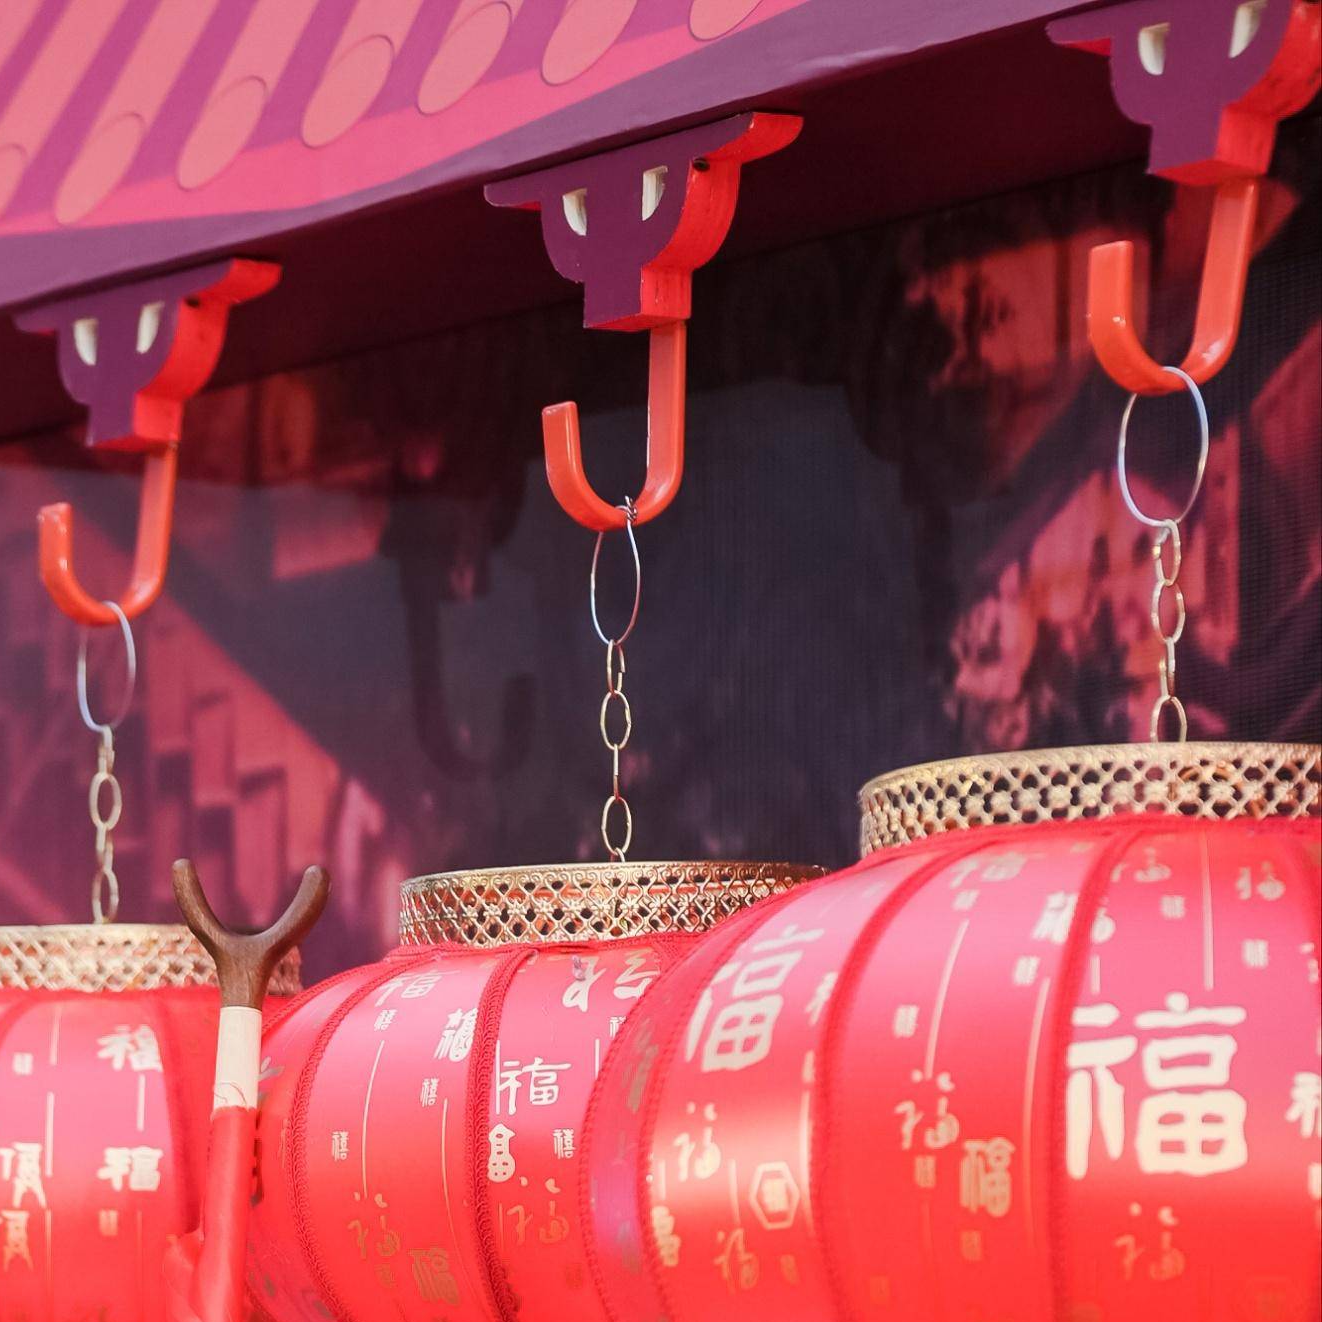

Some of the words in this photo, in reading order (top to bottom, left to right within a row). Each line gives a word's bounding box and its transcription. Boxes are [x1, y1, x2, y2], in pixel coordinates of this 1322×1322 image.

[685, 924, 825, 1072] 福
[500, 1057, 572, 1116] 福
[1064, 992, 1249, 1180] 福
